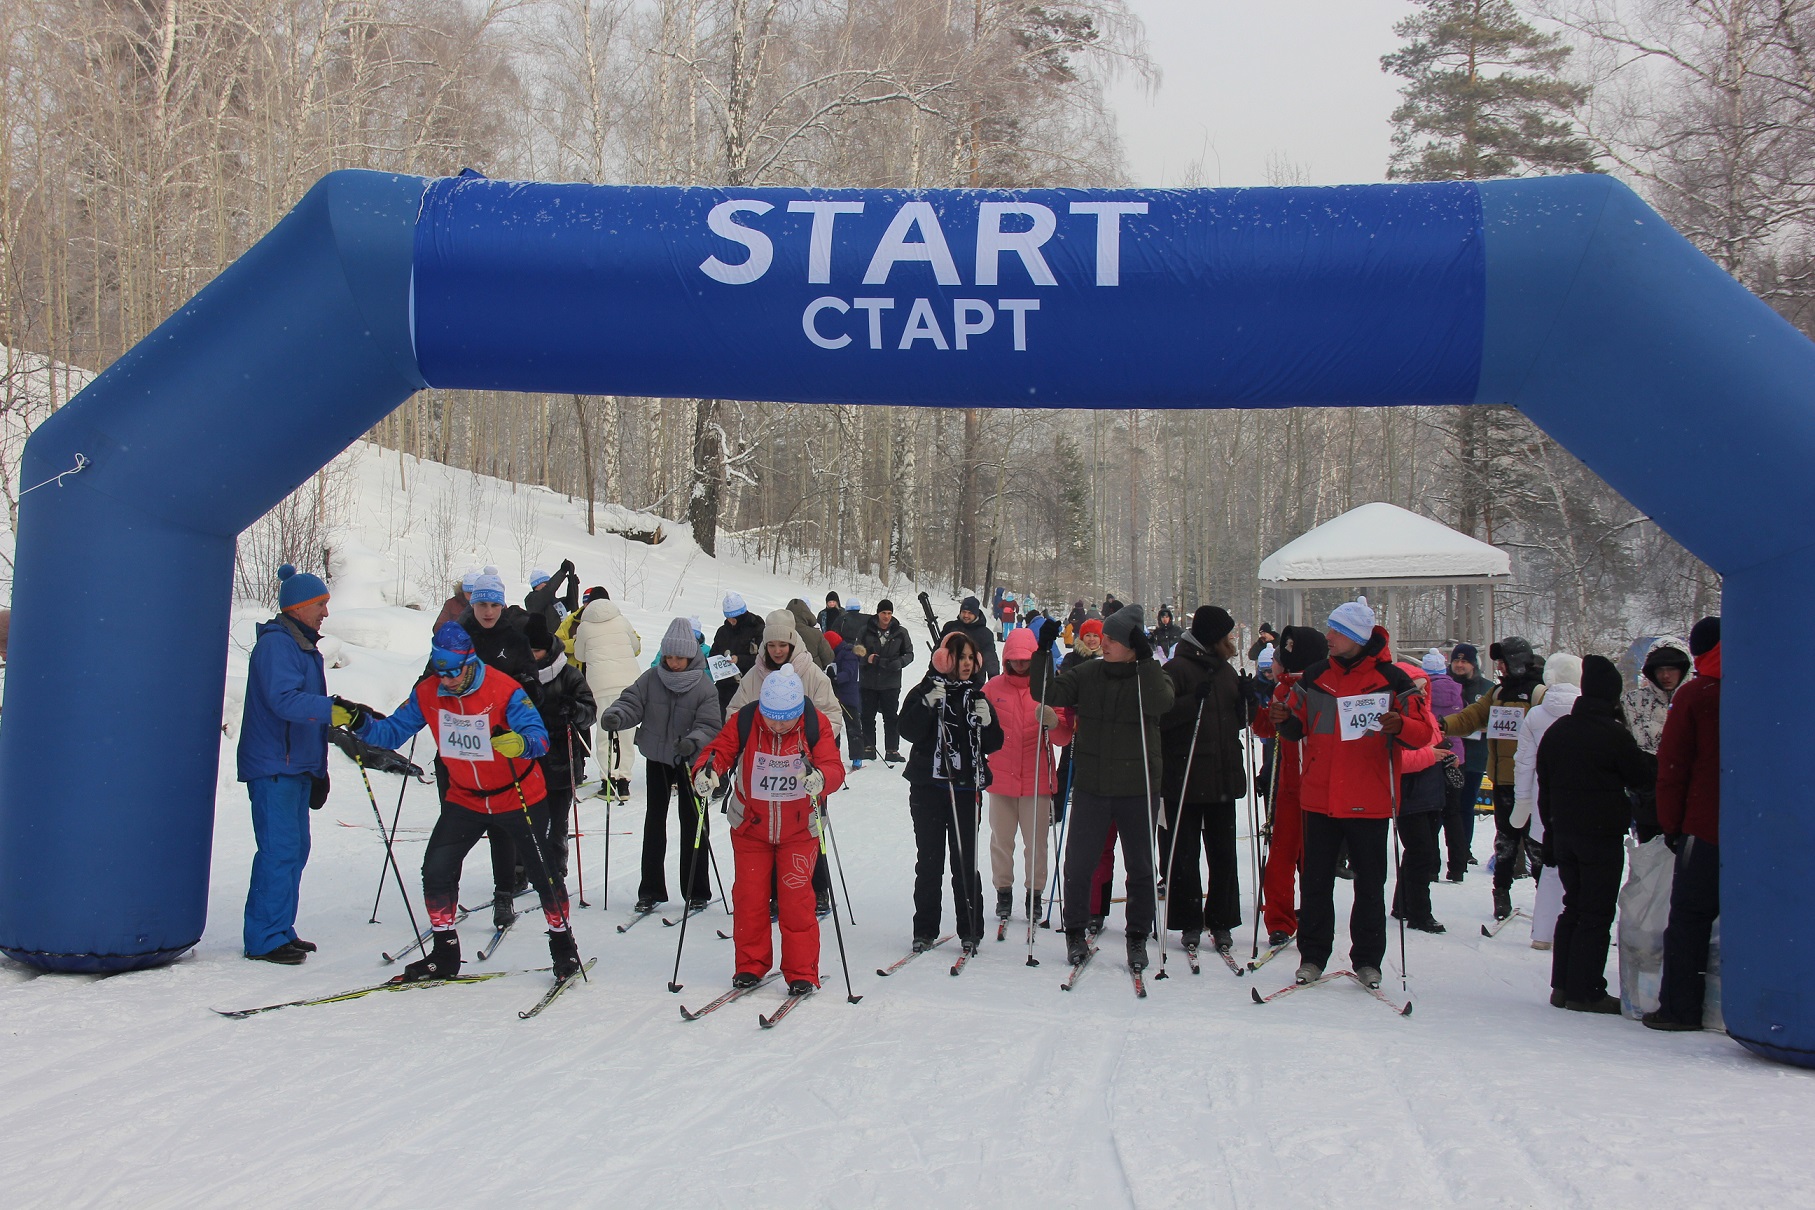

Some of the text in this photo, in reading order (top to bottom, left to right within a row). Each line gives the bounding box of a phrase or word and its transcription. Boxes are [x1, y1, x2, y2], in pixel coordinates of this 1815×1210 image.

[699, 199, 1149, 287] START
[802, 296, 1041, 351] СТАРТ
[1493, 720, 1517, 731] 4442
[448, 731, 481, 750] 4400
[760, 776, 798, 791] 4729
